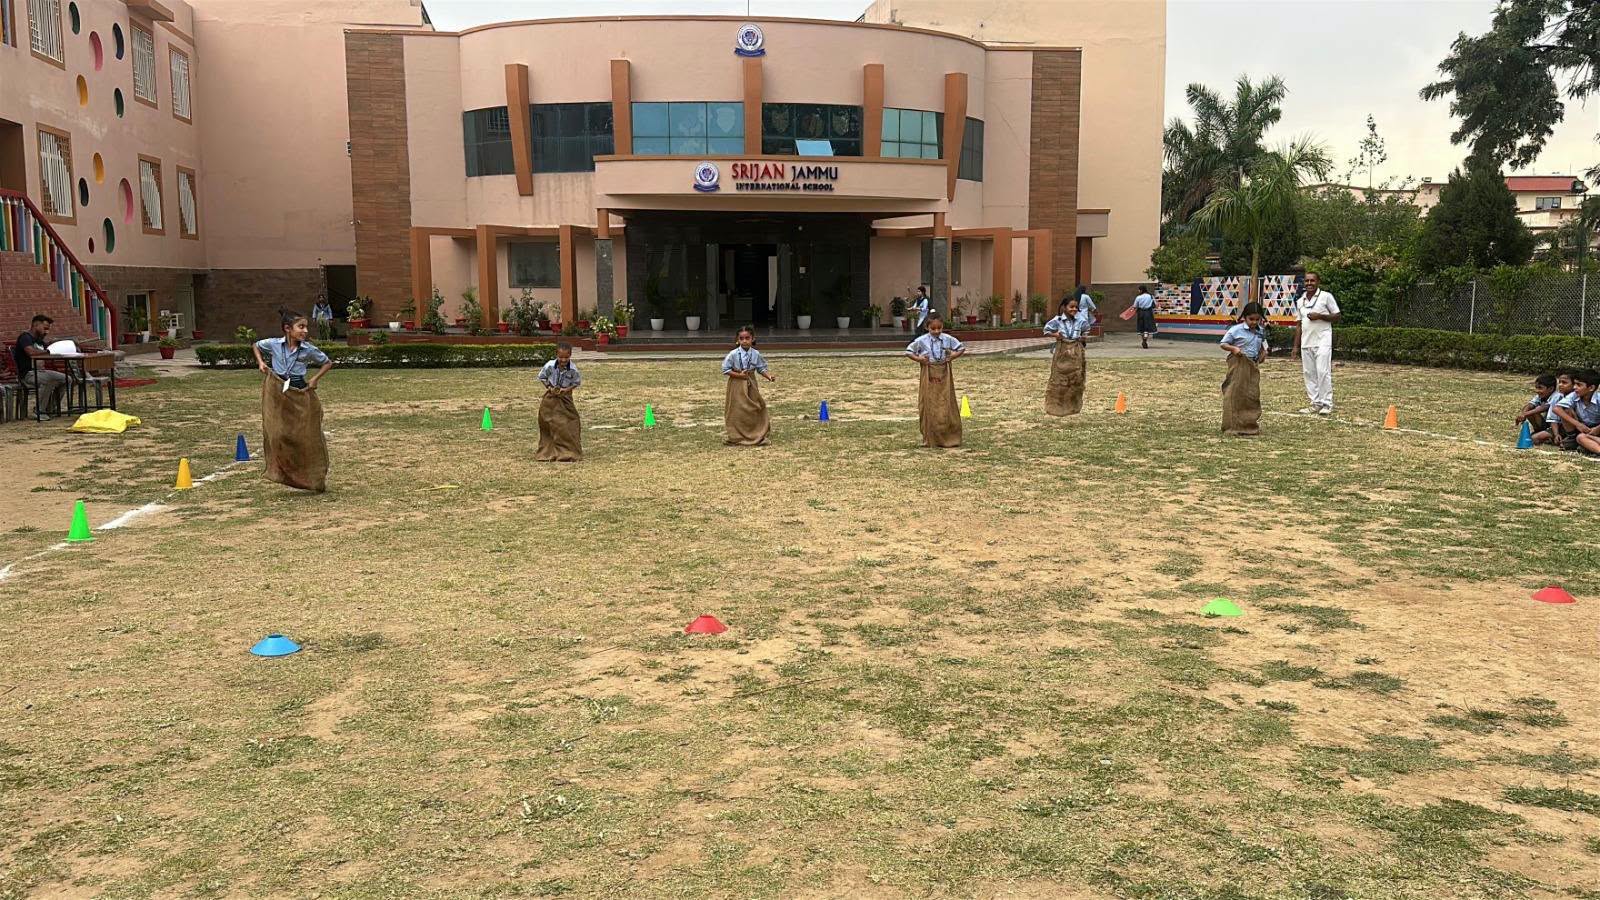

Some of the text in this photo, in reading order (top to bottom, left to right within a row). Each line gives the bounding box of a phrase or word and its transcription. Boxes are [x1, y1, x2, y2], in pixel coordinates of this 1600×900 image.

[731, 163, 785, 182] SRIJAN
[791, 166, 838, 182] JAMMU
[736, 183, 800, 191] INTERNATIONAL
